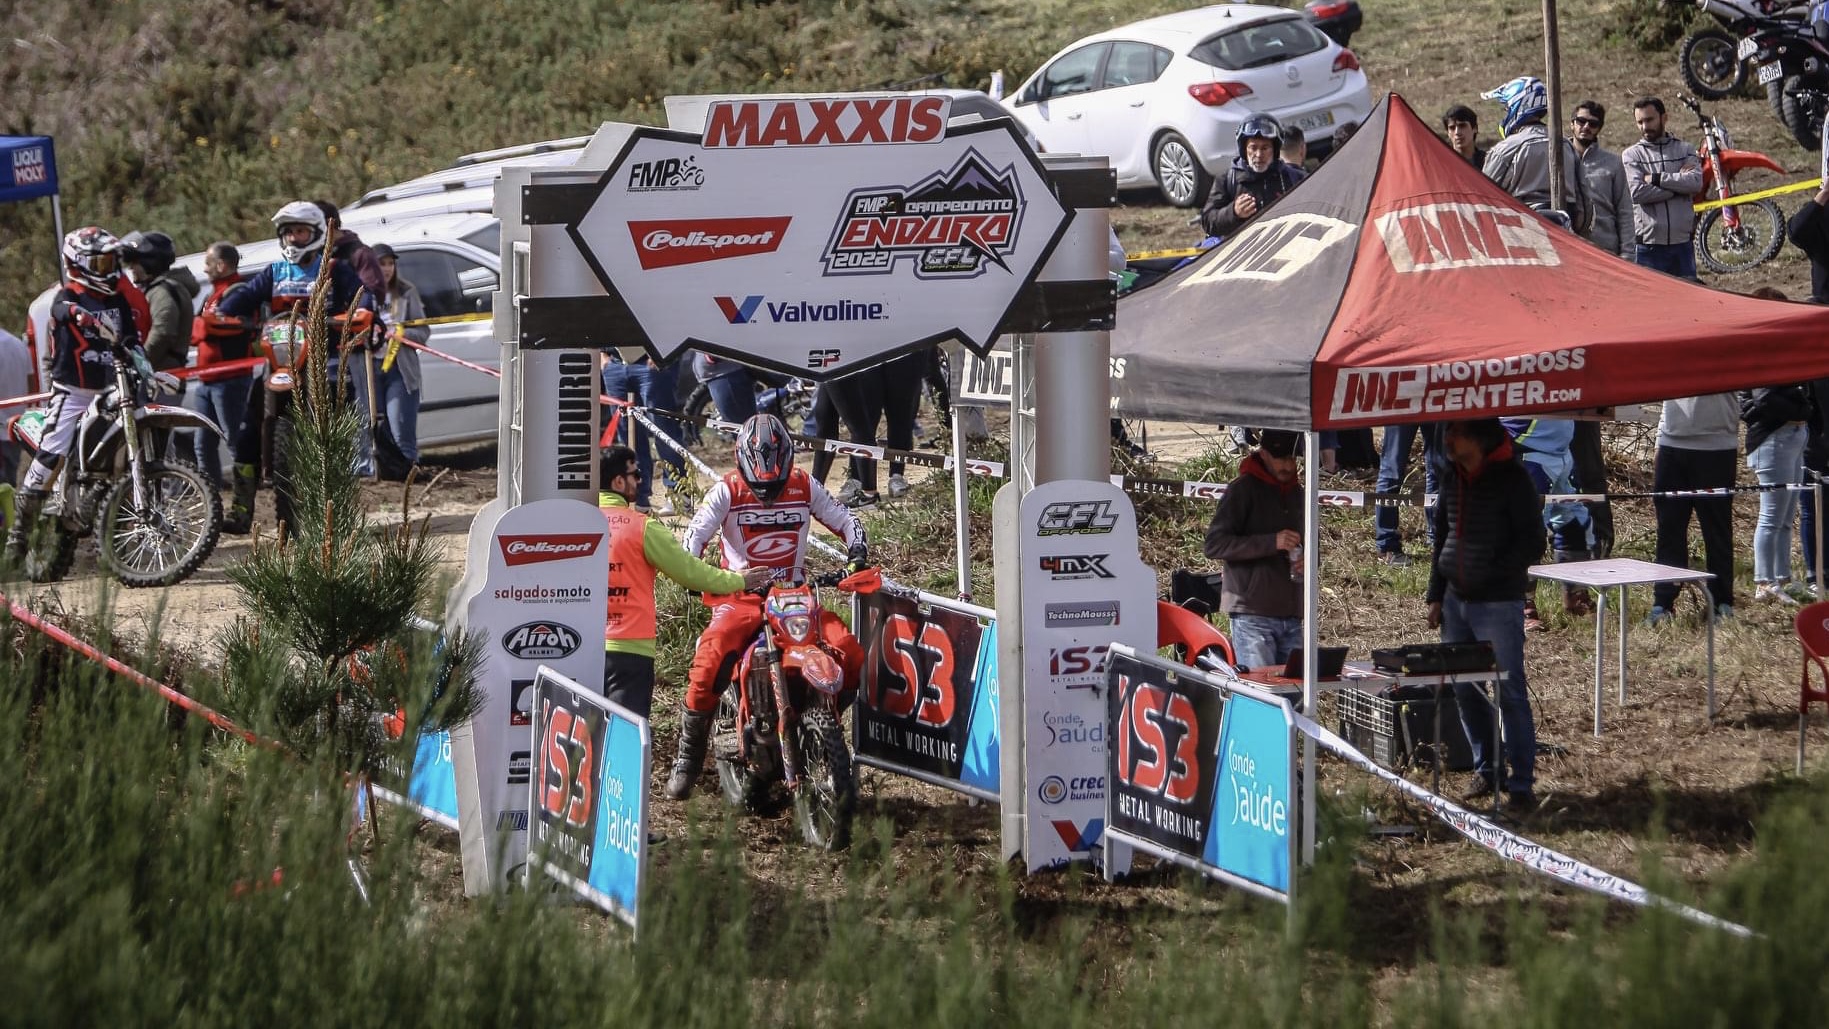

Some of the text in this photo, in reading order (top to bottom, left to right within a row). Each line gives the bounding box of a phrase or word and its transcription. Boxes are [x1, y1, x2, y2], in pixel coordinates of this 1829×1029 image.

[704, 97, 945, 147] MAXXIS
[15, 165, 45, 185] MOLY
[627, 157, 681, 187] FMP
[905, 199, 1013, 213] CAMPEONATO
[643, 230, 775, 250] Polisport
[838, 214, 1012, 249] ENDURO
[834, 250, 888, 267] 2022
[767, 300, 883, 323] Valvoline
[1430, 348, 1586, 386] MOTOCROSS
[558, 353, 591, 489] ENDURO
[894, 454, 934, 467] METAL
[1134, 481, 1173, 492] METAL
[1375, 498, 1414, 507] METAL
[738, 511, 804, 526] Beta
[507, 540, 592, 555] Polisport
[494, 584, 591, 602] salgadosmoto
[508, 627, 576, 650] Airoh
[868, 719, 958, 763] METAL WORKING
[1119, 792, 1202, 840] METAL WORKING
